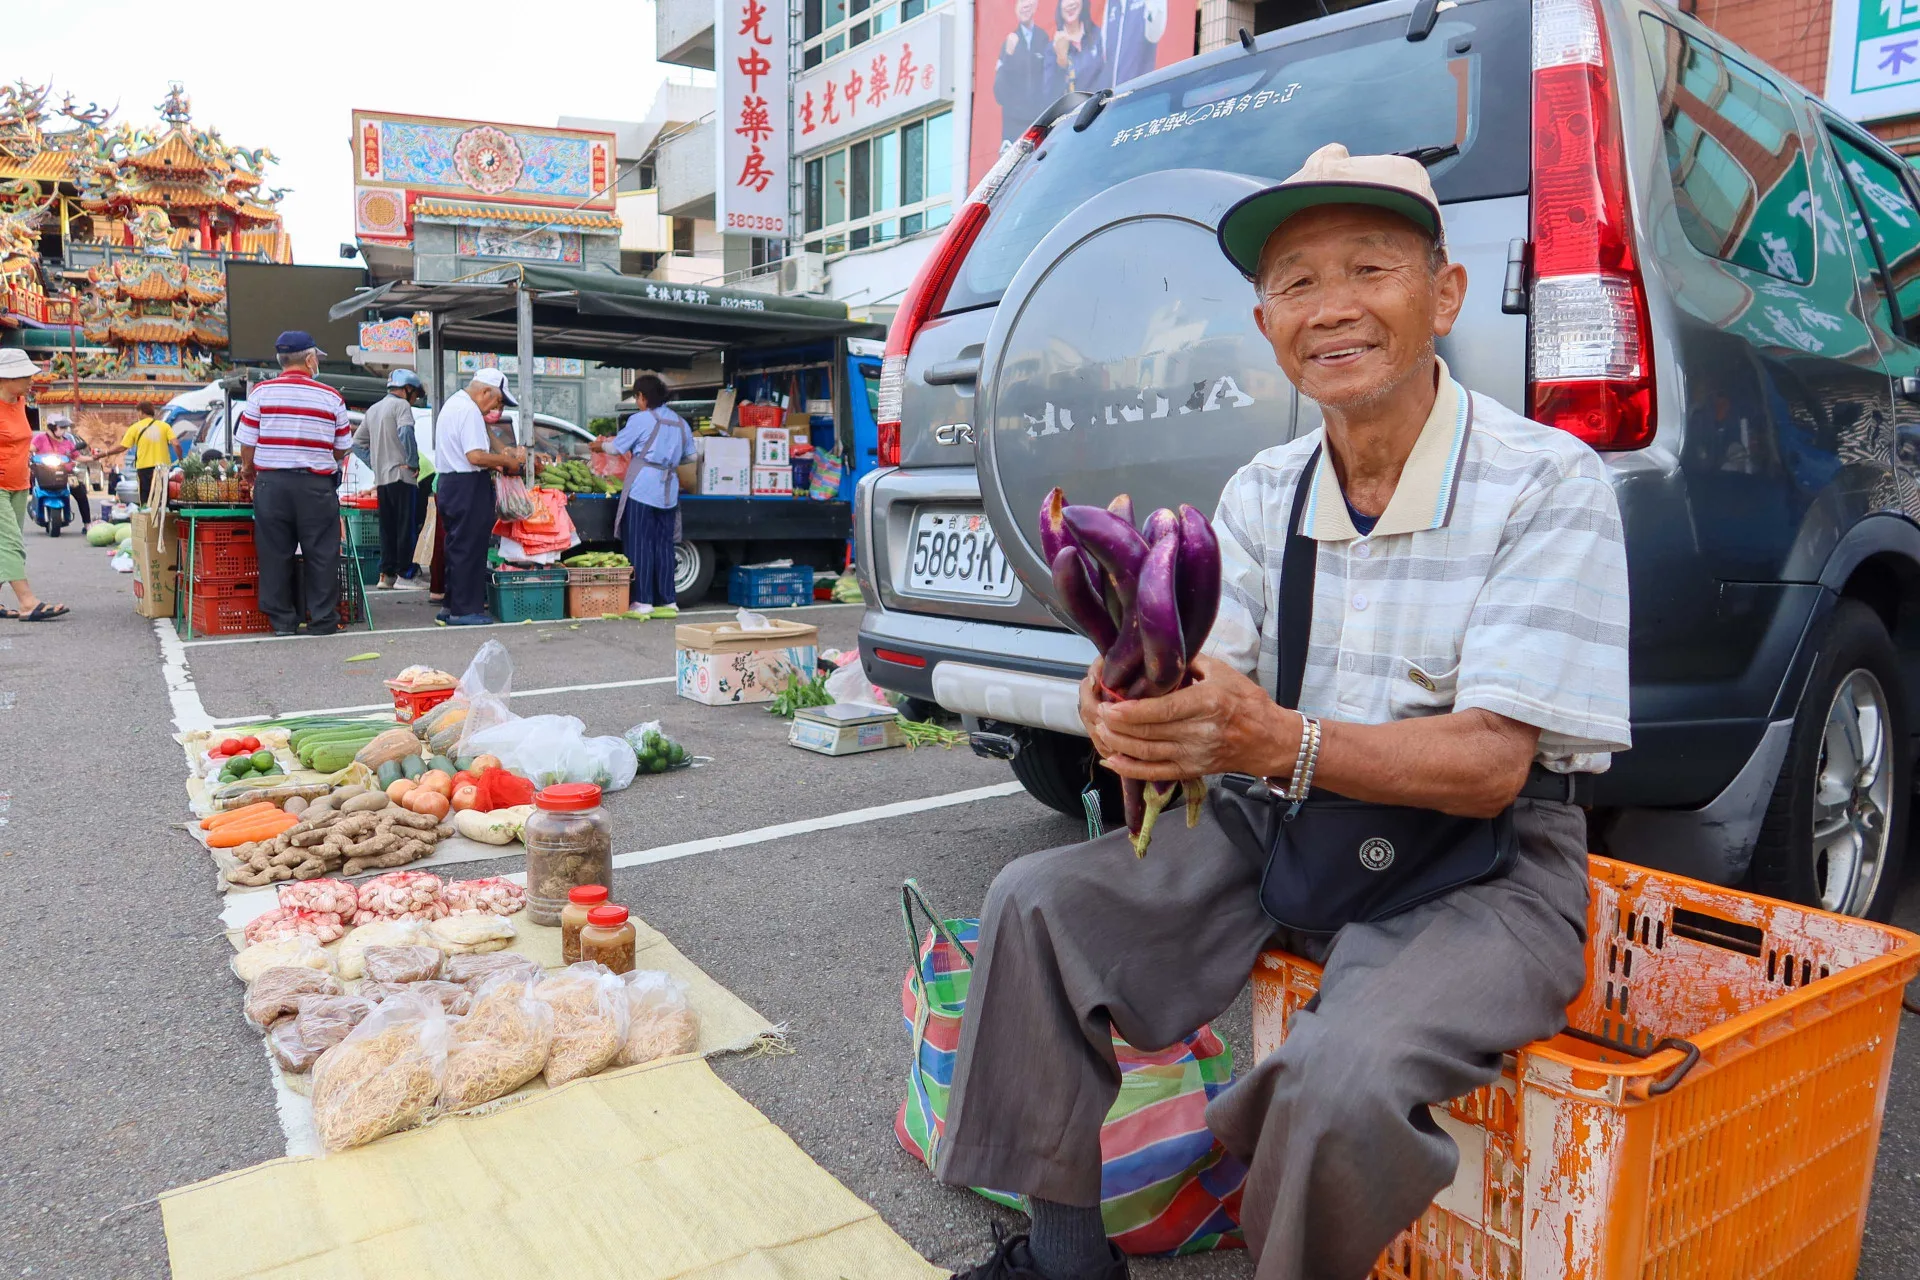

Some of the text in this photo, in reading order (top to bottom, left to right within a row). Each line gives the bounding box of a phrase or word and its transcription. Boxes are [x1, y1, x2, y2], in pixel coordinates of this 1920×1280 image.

[735, 0, 775, 193] 光中藥房
[798, 42, 919, 136] 生光中藥房
[727, 212, 784, 232] 380380
